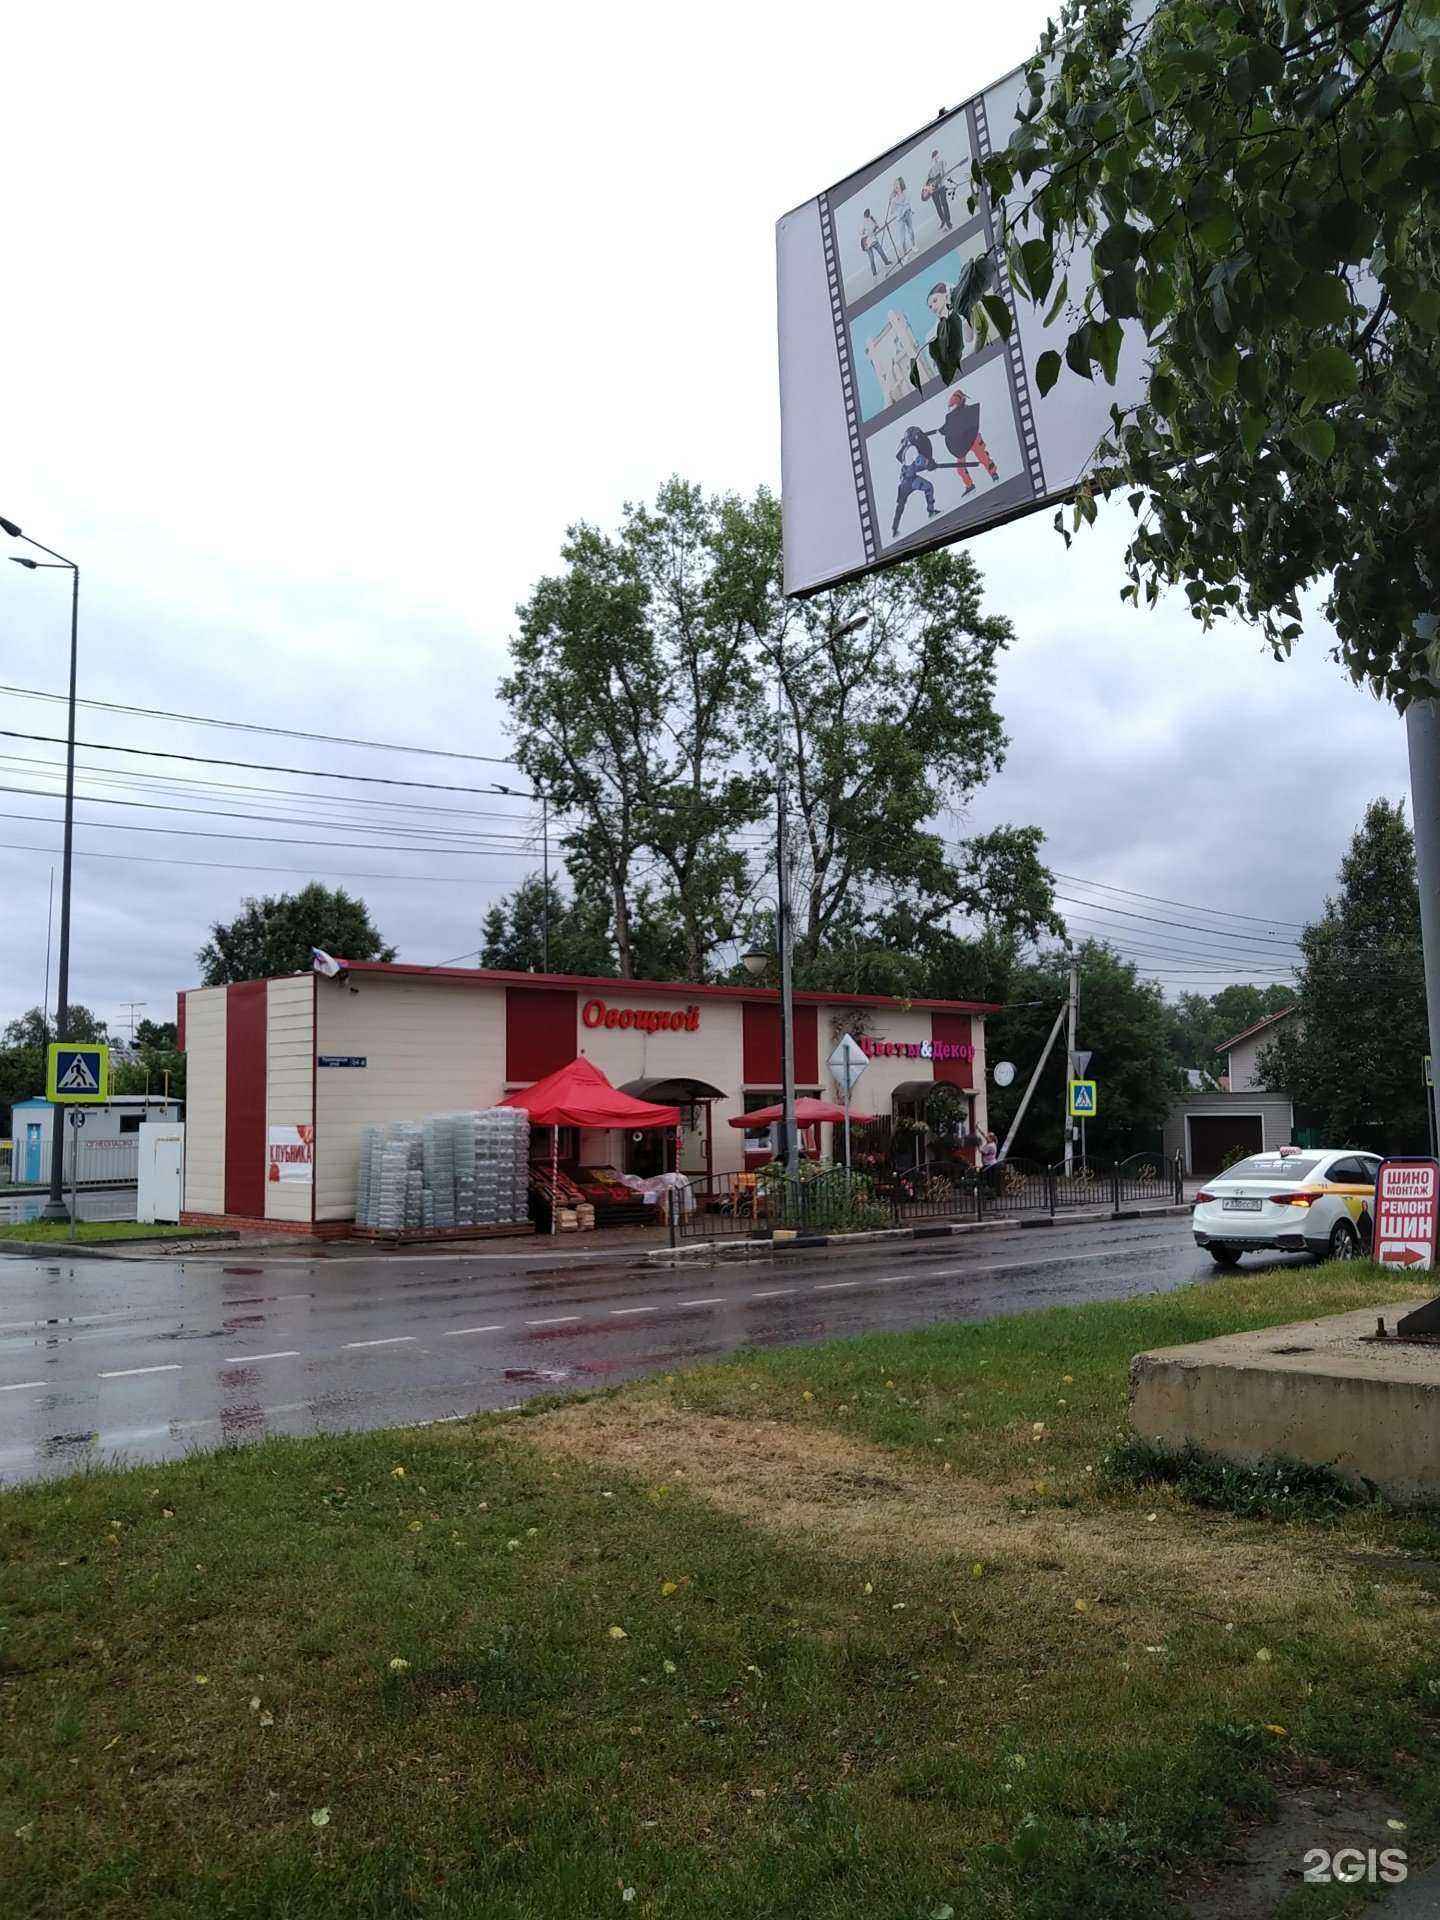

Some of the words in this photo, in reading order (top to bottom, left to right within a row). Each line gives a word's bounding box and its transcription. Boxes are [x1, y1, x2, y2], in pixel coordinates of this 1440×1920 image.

[582, 999, 700, 1034] Овощной
[269, 1143, 312, 1164] КЛУБНИКА
[1388, 1171, 1429, 1185] ШИНО
[1386, 1185, 1429, 1196] МОНТАЖ
[1381, 1201, 1432, 1214] РЕМОНТ
[1380, 1216, 1432, 1238] ШИН
